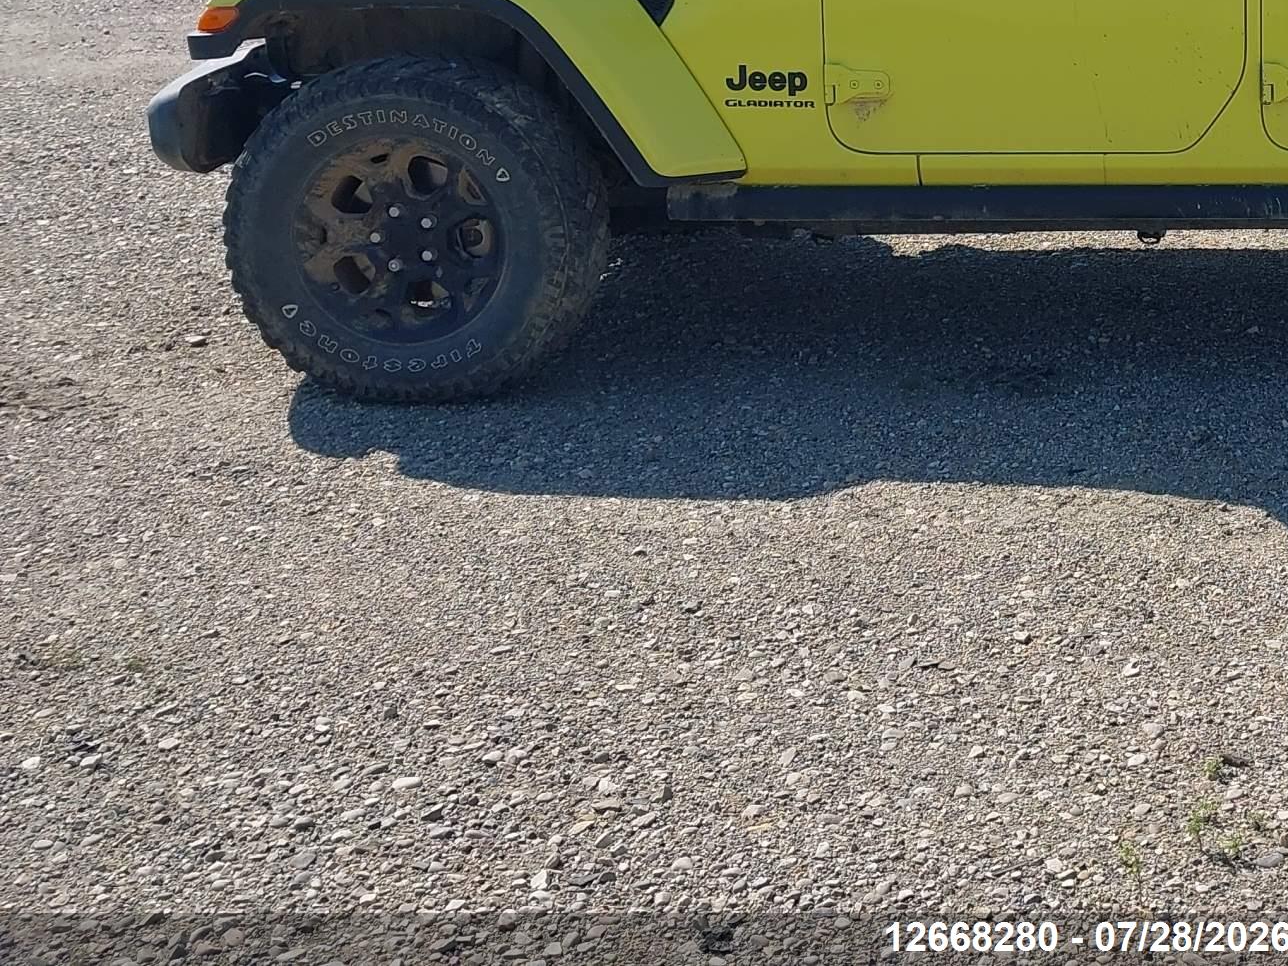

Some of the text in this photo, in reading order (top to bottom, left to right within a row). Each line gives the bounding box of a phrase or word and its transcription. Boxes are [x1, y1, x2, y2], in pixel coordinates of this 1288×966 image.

[725, 65, 808, 96] Jeep
[724, 99, 816, 109] GLADIATOR
[306, 109, 496, 167] DESTINATION
[299, 320, 482, 373] Firestone
